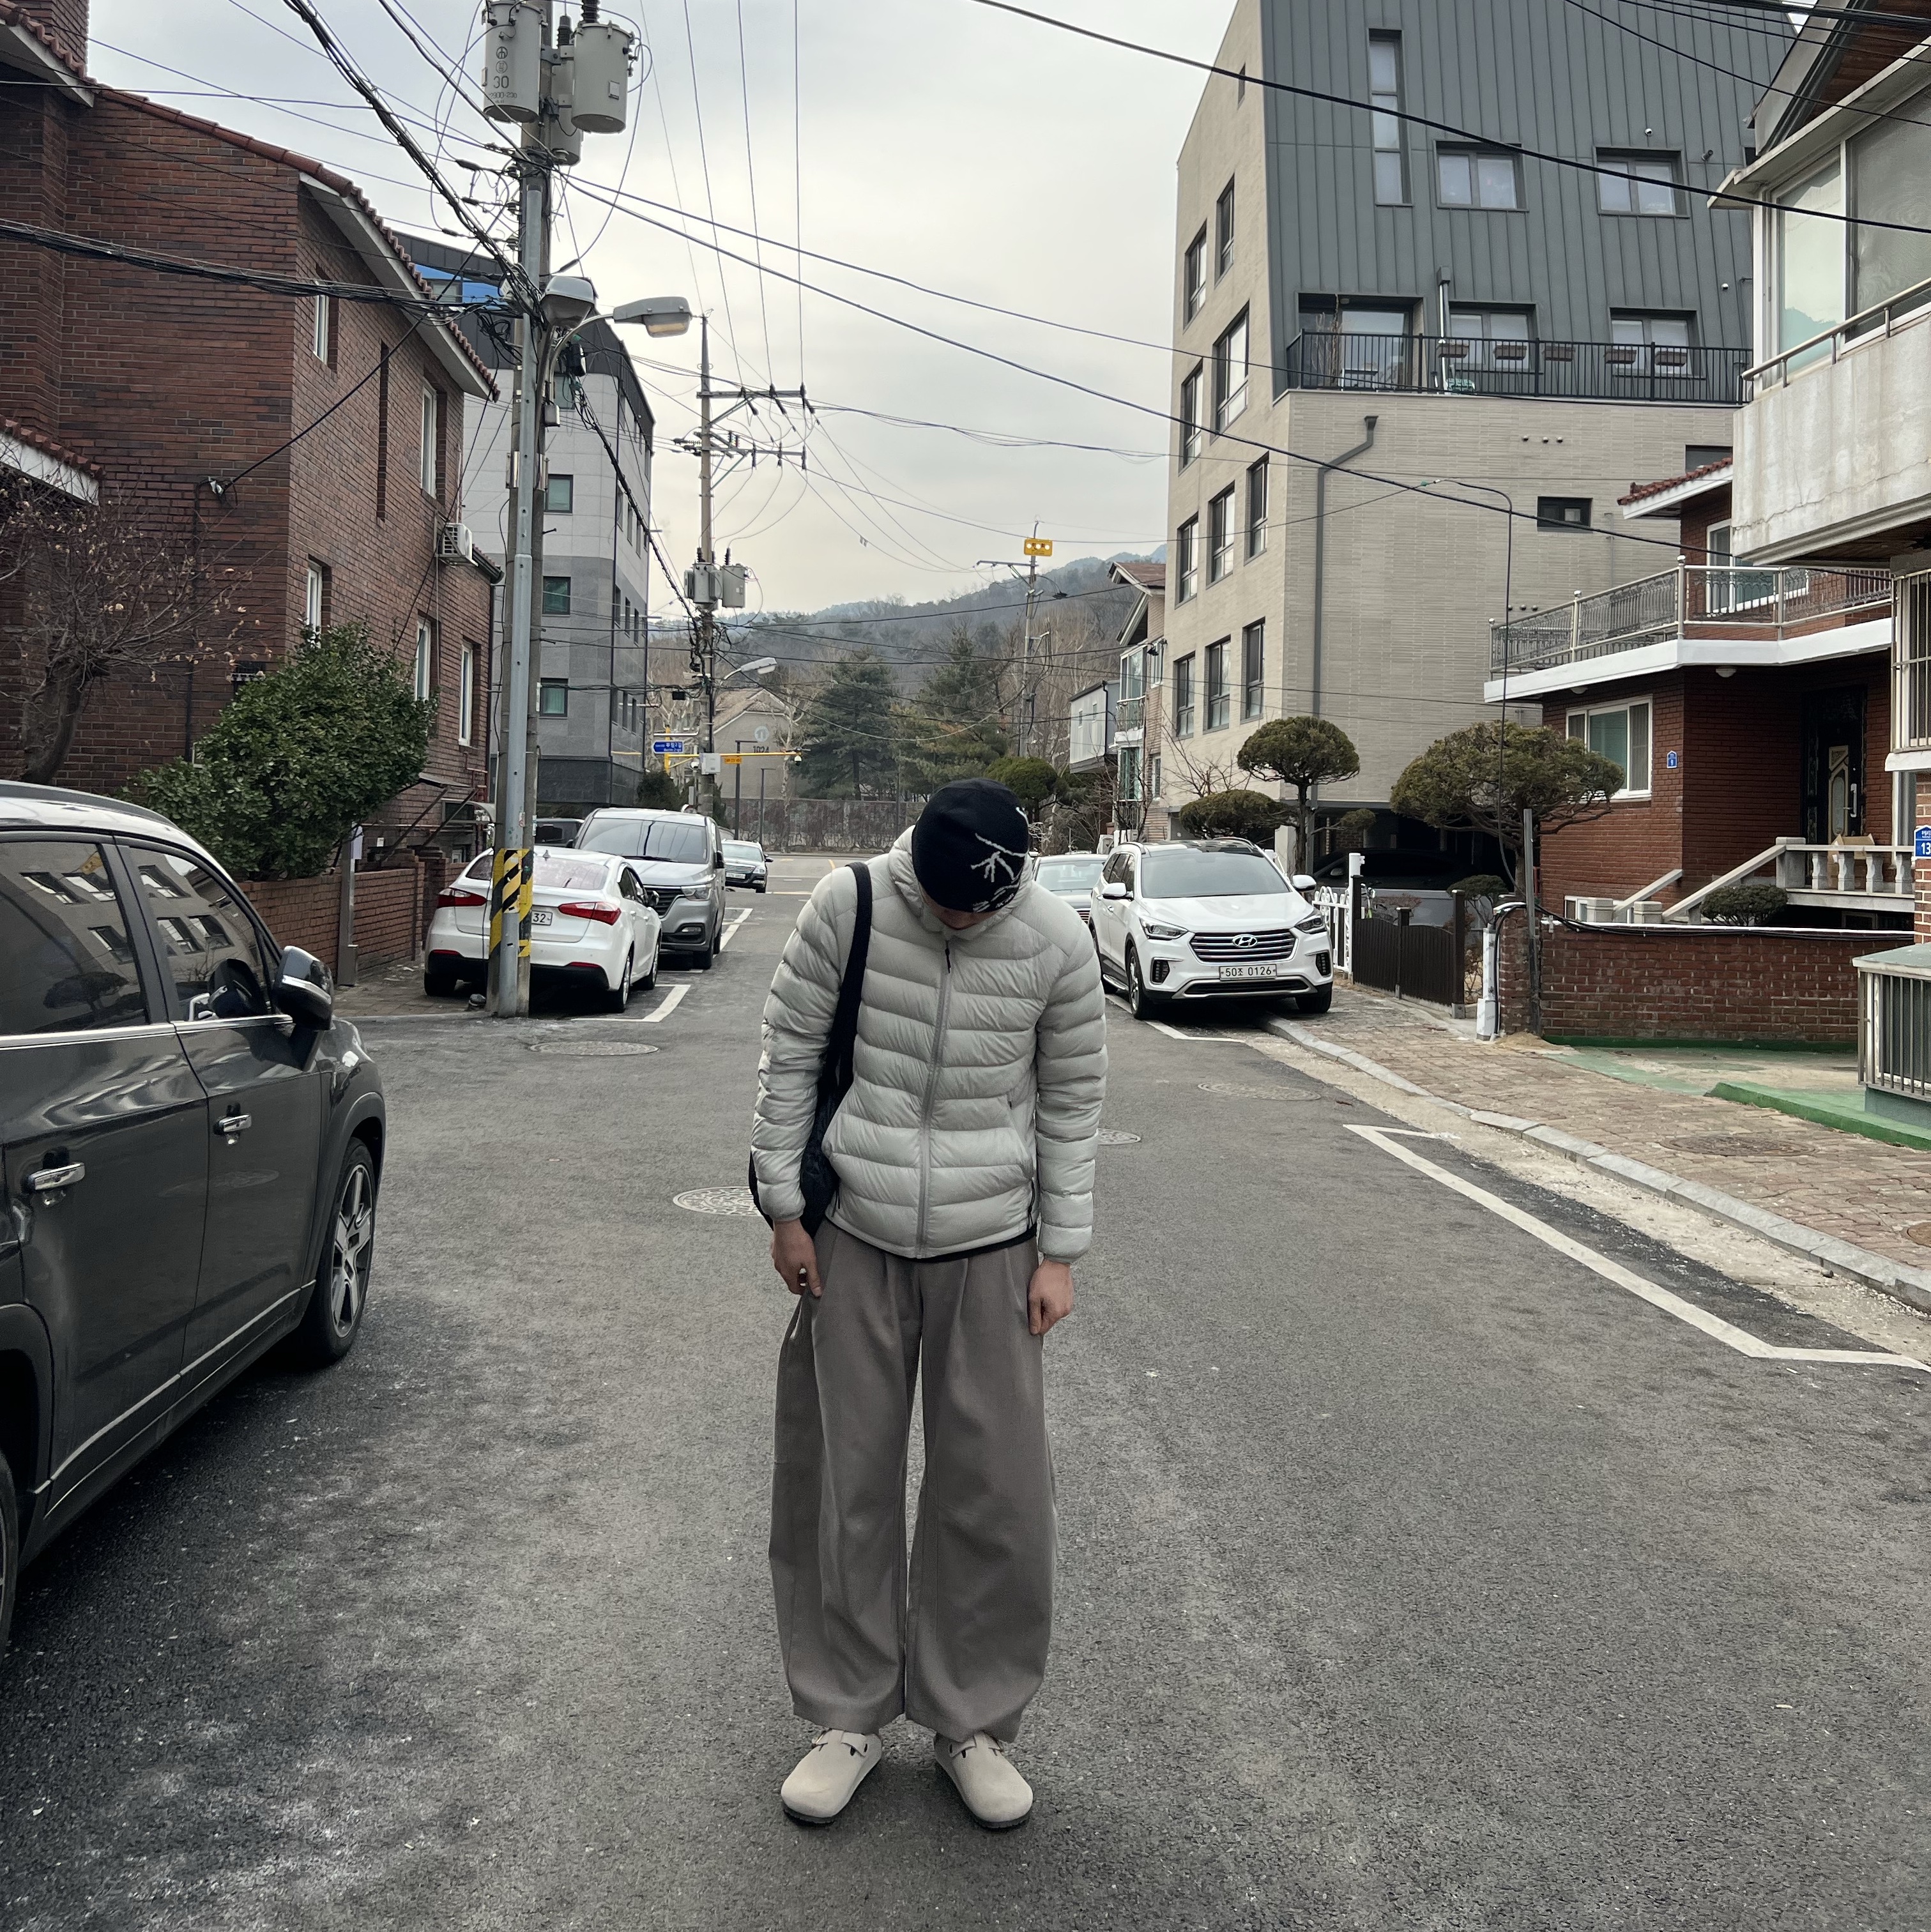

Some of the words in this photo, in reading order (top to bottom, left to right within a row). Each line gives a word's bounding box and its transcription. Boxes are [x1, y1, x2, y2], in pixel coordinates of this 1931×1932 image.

[493, 75, 509, 88] 30
[1921, 842, 1931, 855] 13
[1225, 968, 1243, 977] 50조
[1248, 966, 1272, 976] 0126
